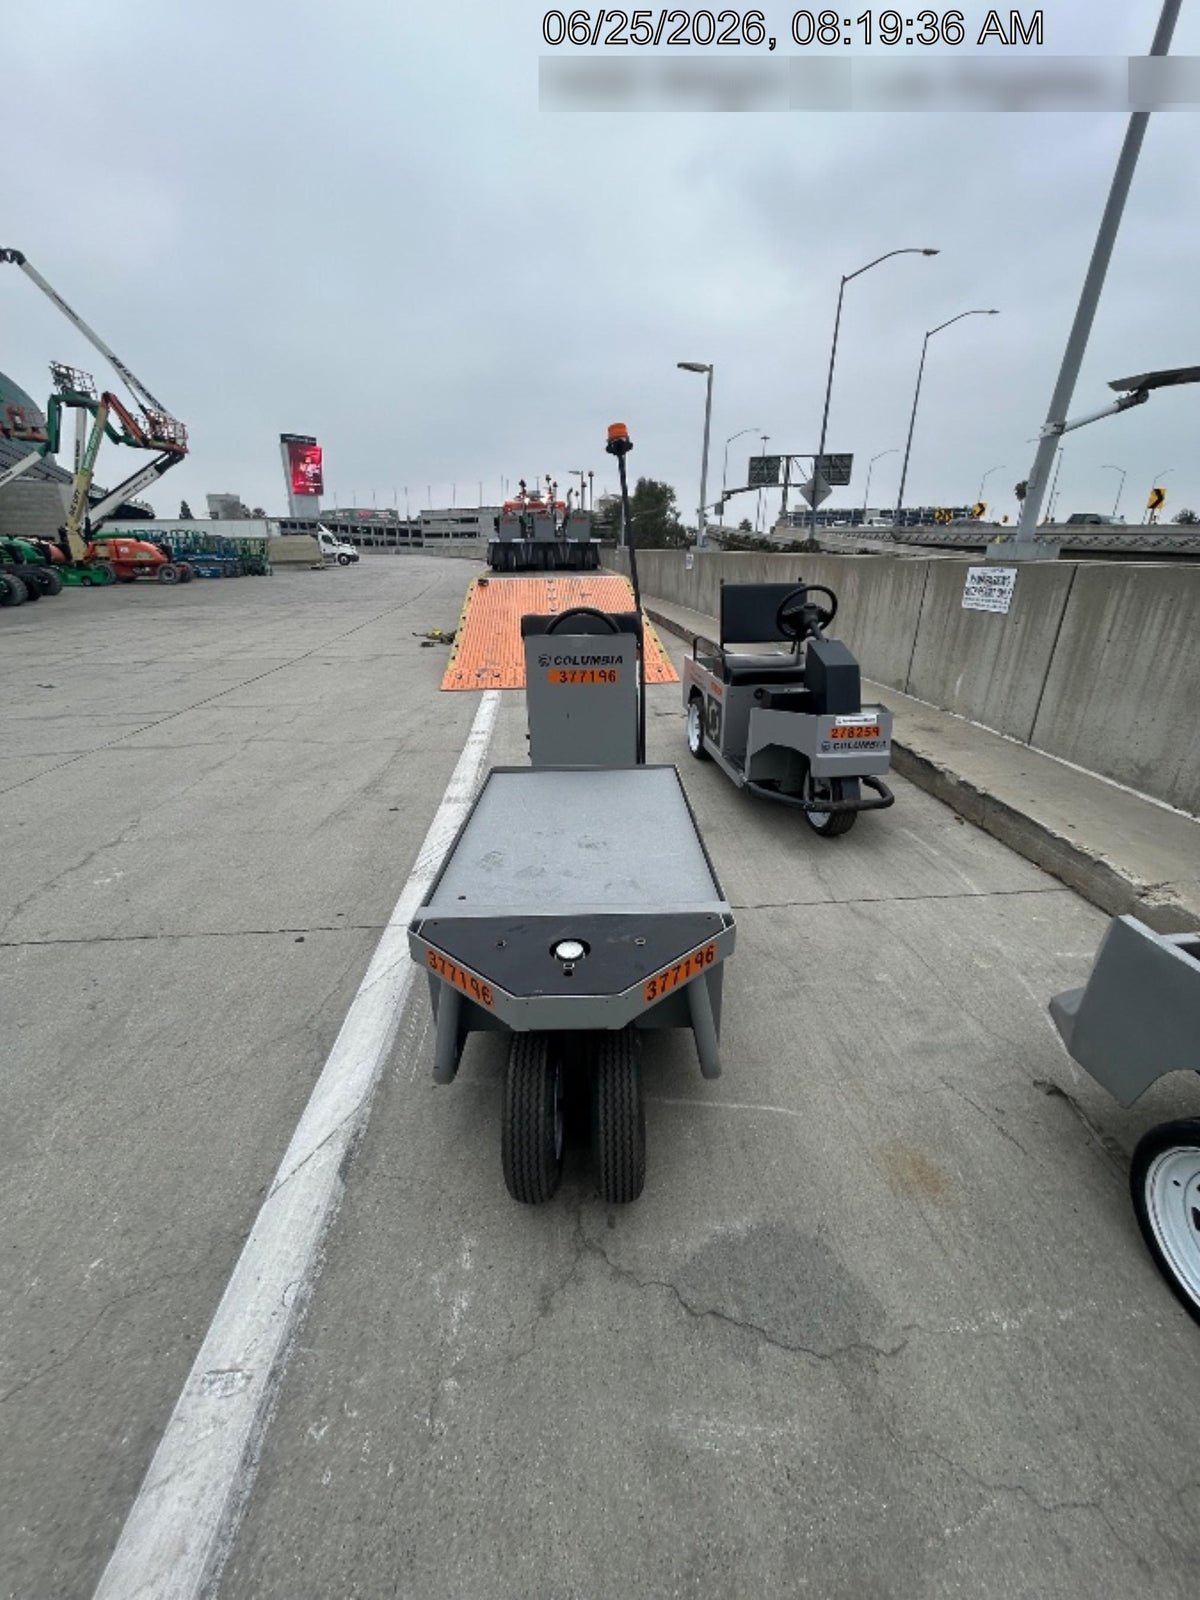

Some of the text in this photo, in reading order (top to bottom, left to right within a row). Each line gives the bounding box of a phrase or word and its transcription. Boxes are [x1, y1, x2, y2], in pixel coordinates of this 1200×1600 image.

[554, 655, 623, 666] COLUMBIA
[559, 670, 617, 683] 377196
[428, 950, 494, 1005] 377196
[646, 944, 715, 1001] 377196
